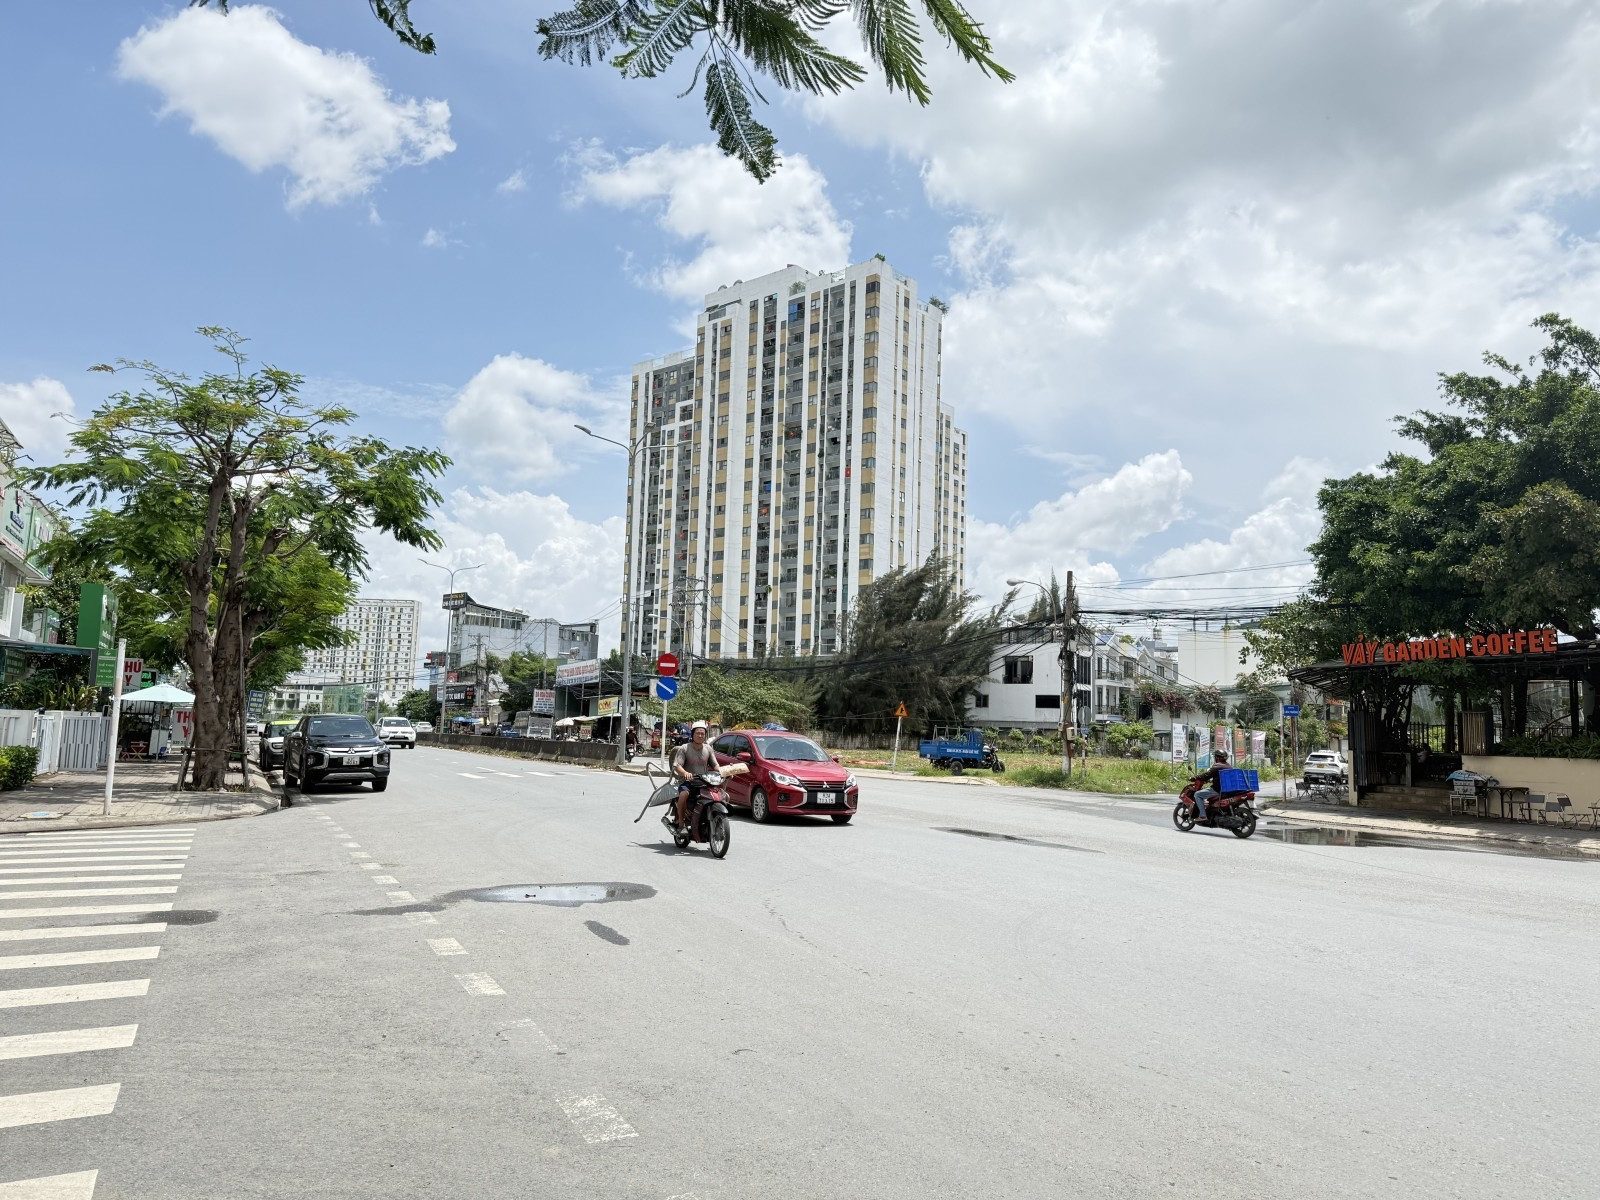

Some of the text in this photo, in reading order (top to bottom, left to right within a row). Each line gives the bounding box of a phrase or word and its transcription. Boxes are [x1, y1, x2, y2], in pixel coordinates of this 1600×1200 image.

[1342, 630, 1557, 665] VẢY GARDEN COFFEE
[124, 659, 142, 673] HÚ
